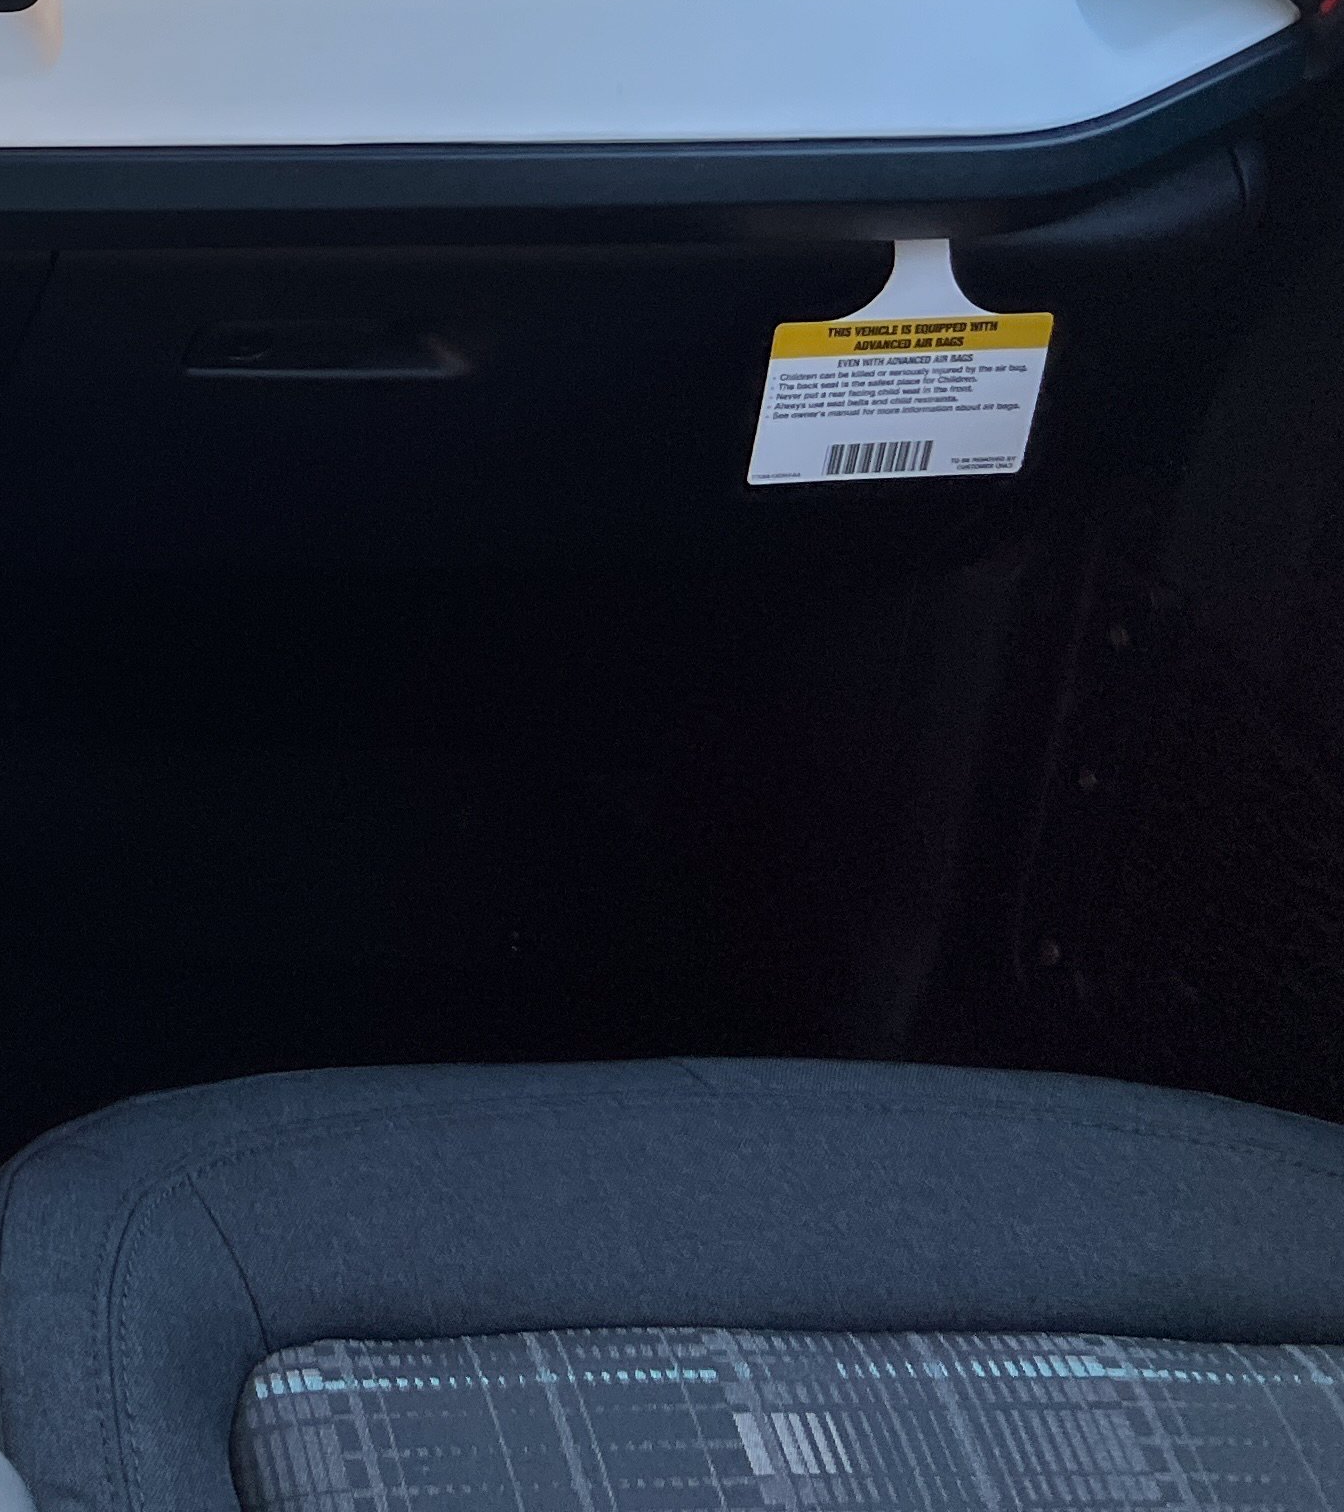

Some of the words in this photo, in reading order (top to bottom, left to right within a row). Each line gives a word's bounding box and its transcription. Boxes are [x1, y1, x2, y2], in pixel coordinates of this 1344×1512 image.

[828, 327, 852, 338] THIS
[854, 324, 898, 337] VEHICLE
[901, 324, 912, 335] IS
[914, 322, 968, 335] EQUIPPED
[970, 321, 998, 332] WITH
[853, 338, 912, 352] ADVANCED
[914, 337, 934, 349] AIR
[935, 336, 965, 348] BAGS
[837, 357, 861, 369] EVEN
[862, 356, 885, 367] WITH
[886, 355, 932, 367] ADVANCED
[933, 354, 949, 364] AIR
[950, 353, 974, 363] BAGS
[780, 372, 818, 383] Children
[819, 372, 836, 381] can
[837, 370, 849, 379] be
[851, 369, 875, 378] killed
[889, 368, 930, 378] seriously
[932, 366, 963, 377] injured
[964, 365, 976, 376] by
[978, 364, 993, 373] the
[994, 364, 1008, 372] air
[779, 382, 795, 391] The
[797, 382, 818, 390] back
[820, 381, 839, 389] seat
[851, 379, 866, 387] the
[867, 378, 895, 387] safest
[897, 377, 920, 386] place
[776, 392, 802, 401] Never
[803, 391, 819, 401] put
[877, 387, 900, 396] child
[933, 385, 948, 393] the
[827, 409, 860, 417] manual
[901, 405, 953, 414] information
[955, 403, 981, 412] about
[847, 398, 869, 407] belts
[870, 398, 887, 406] and
